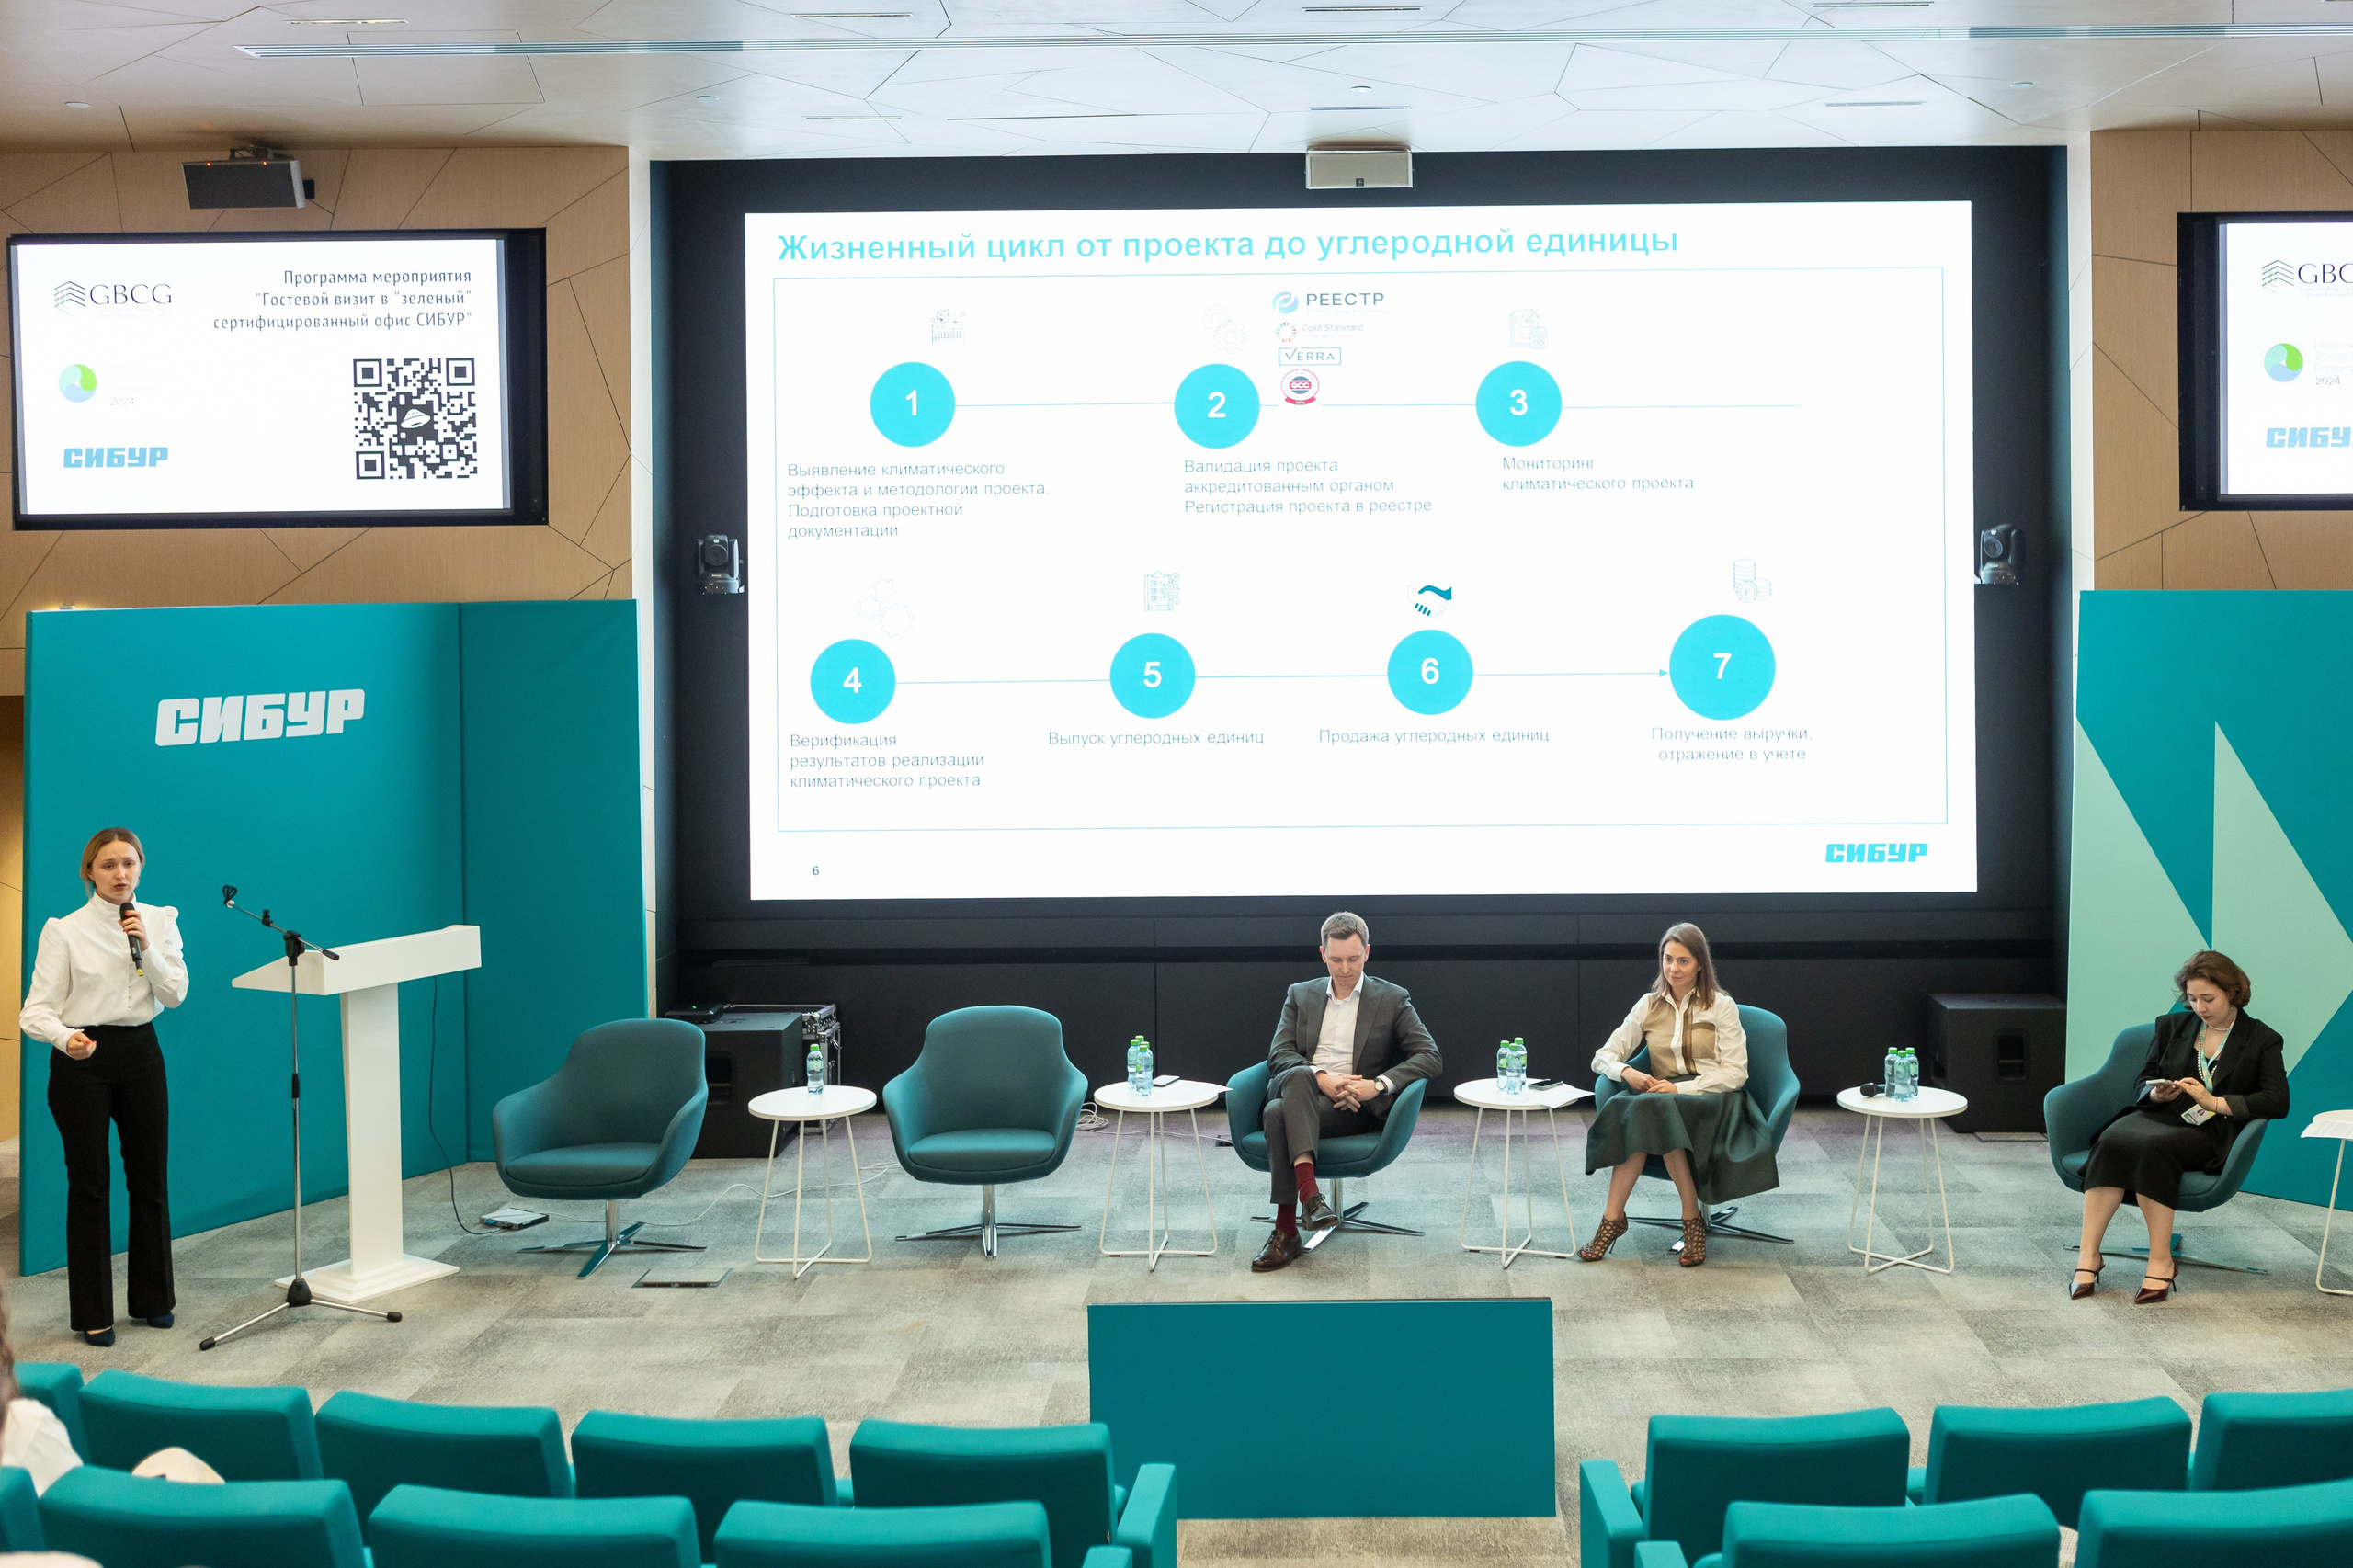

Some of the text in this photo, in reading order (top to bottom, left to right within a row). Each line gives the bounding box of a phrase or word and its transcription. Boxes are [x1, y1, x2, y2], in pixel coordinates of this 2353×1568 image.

[778, 228, 1677, 263] Жизненный цикл от проекта до углеродной единицы
[285, 271, 471, 287] Программа мероприятия
[89, 283, 172, 305] GBCG
[256, 291, 471, 305] "Гостевой визит в "зеленый"
[1307, 293, 1384, 306] РЕЕСТР
[214, 312, 472, 332] сертифицированный офис СИБУР"
[1302, 324, 1363, 332] Gold Standard
[1284, 348, 1335, 360] VERRA
[2316, 377, 2340, 385] 2024
[906, 390, 916, 415] 1
[1208, 392, 1225, 417] 2
[1510, 389, 1528, 415] 3
[2266, 427, 2353, 448] СИБУ
[63, 448, 168, 468] СИБУР
[1503, 457, 1596, 473] Мониторинг
[787, 463, 1005, 478] Выявление климатического
[1185, 460, 1338, 475] Валидация проекта
[789, 483, 1049, 500] эффекта и методологии проекта.
[1185, 482, 1324, 496] аккредитованным
[1503, 478, 1693, 492] климатического проекта
[789, 503, 962, 519] Подготовка проектной
[1185, 501, 1433, 516] Регистрация проекта в реестре
[787, 526, 898, 540] документации
[1421, 658, 1439, 684] 6
[1714, 653, 1731, 679] 7
[843, 667, 861, 693] 4
[1144, 662, 1161, 687] 5
[155, 689, 365, 745] СИБУР
[790, 733, 896, 750] Верификация
[1049, 732, 1264, 748] Выпуск углеродных единиц
[1320, 729, 1549, 745] Продажа углеродных единиц
[1653, 726, 1812, 743] Получение выручки,
[790, 756, 983, 770] результатов реализации
[1659, 750, 1806, 763] отражение в учете
[790, 776, 980, 790] климатического проекта
[1825, 843, 1927, 863] СИБУР
[813, 866, 819, 875] 6
